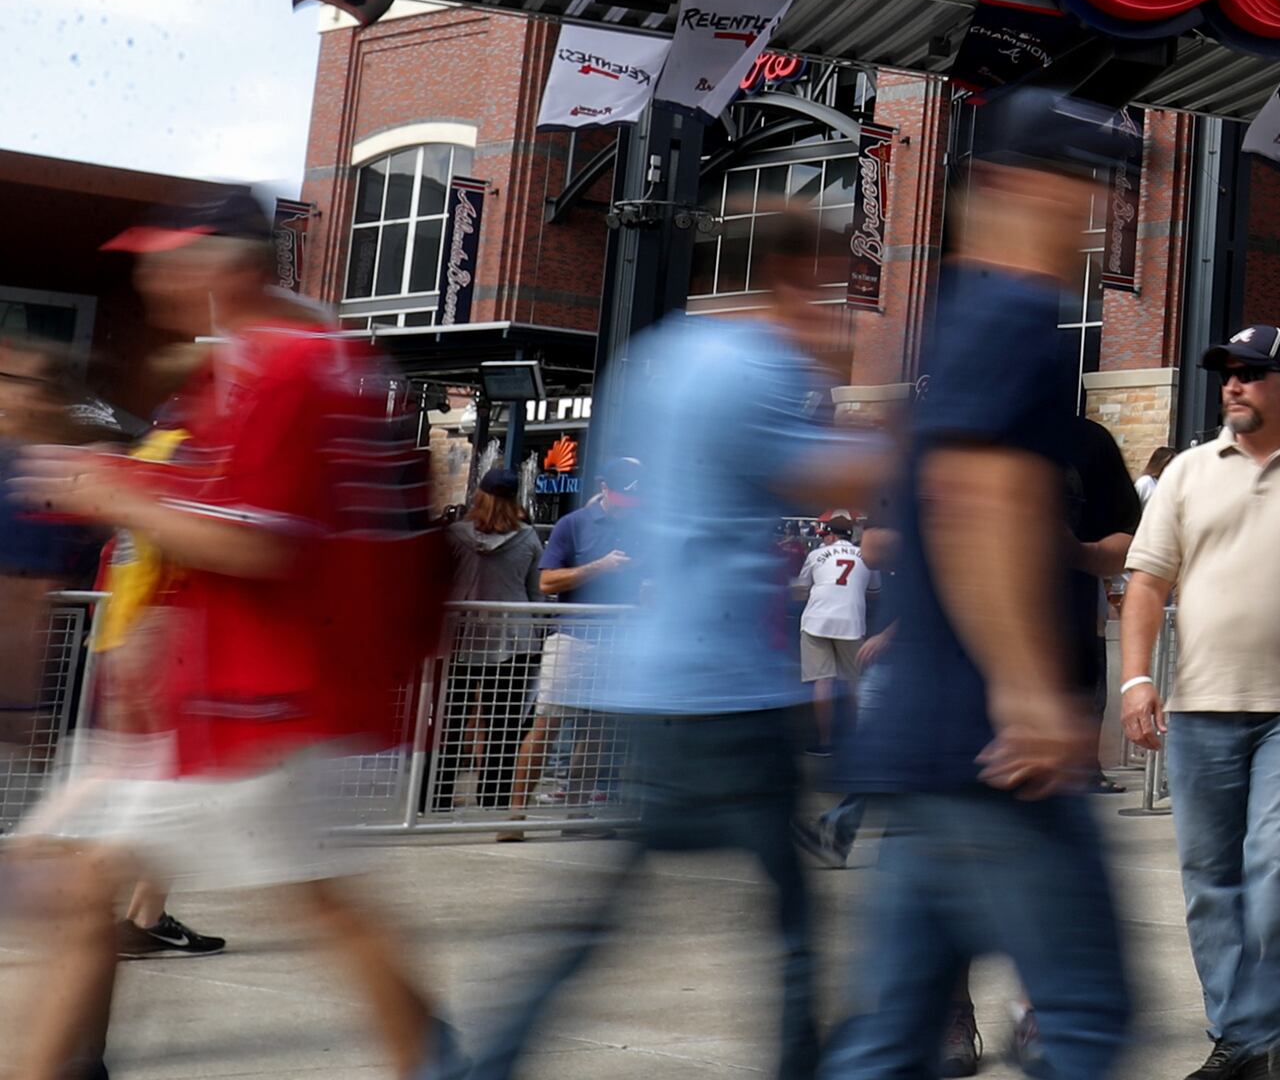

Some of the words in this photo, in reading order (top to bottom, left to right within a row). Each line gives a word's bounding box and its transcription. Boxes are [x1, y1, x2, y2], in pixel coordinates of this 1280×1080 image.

[969, 25, 1053, 68] CHAMPION
[850, 156, 884, 265] Braves
[816, 547, 864, 564] SWANSO
[835, 559, 855, 586] 7
